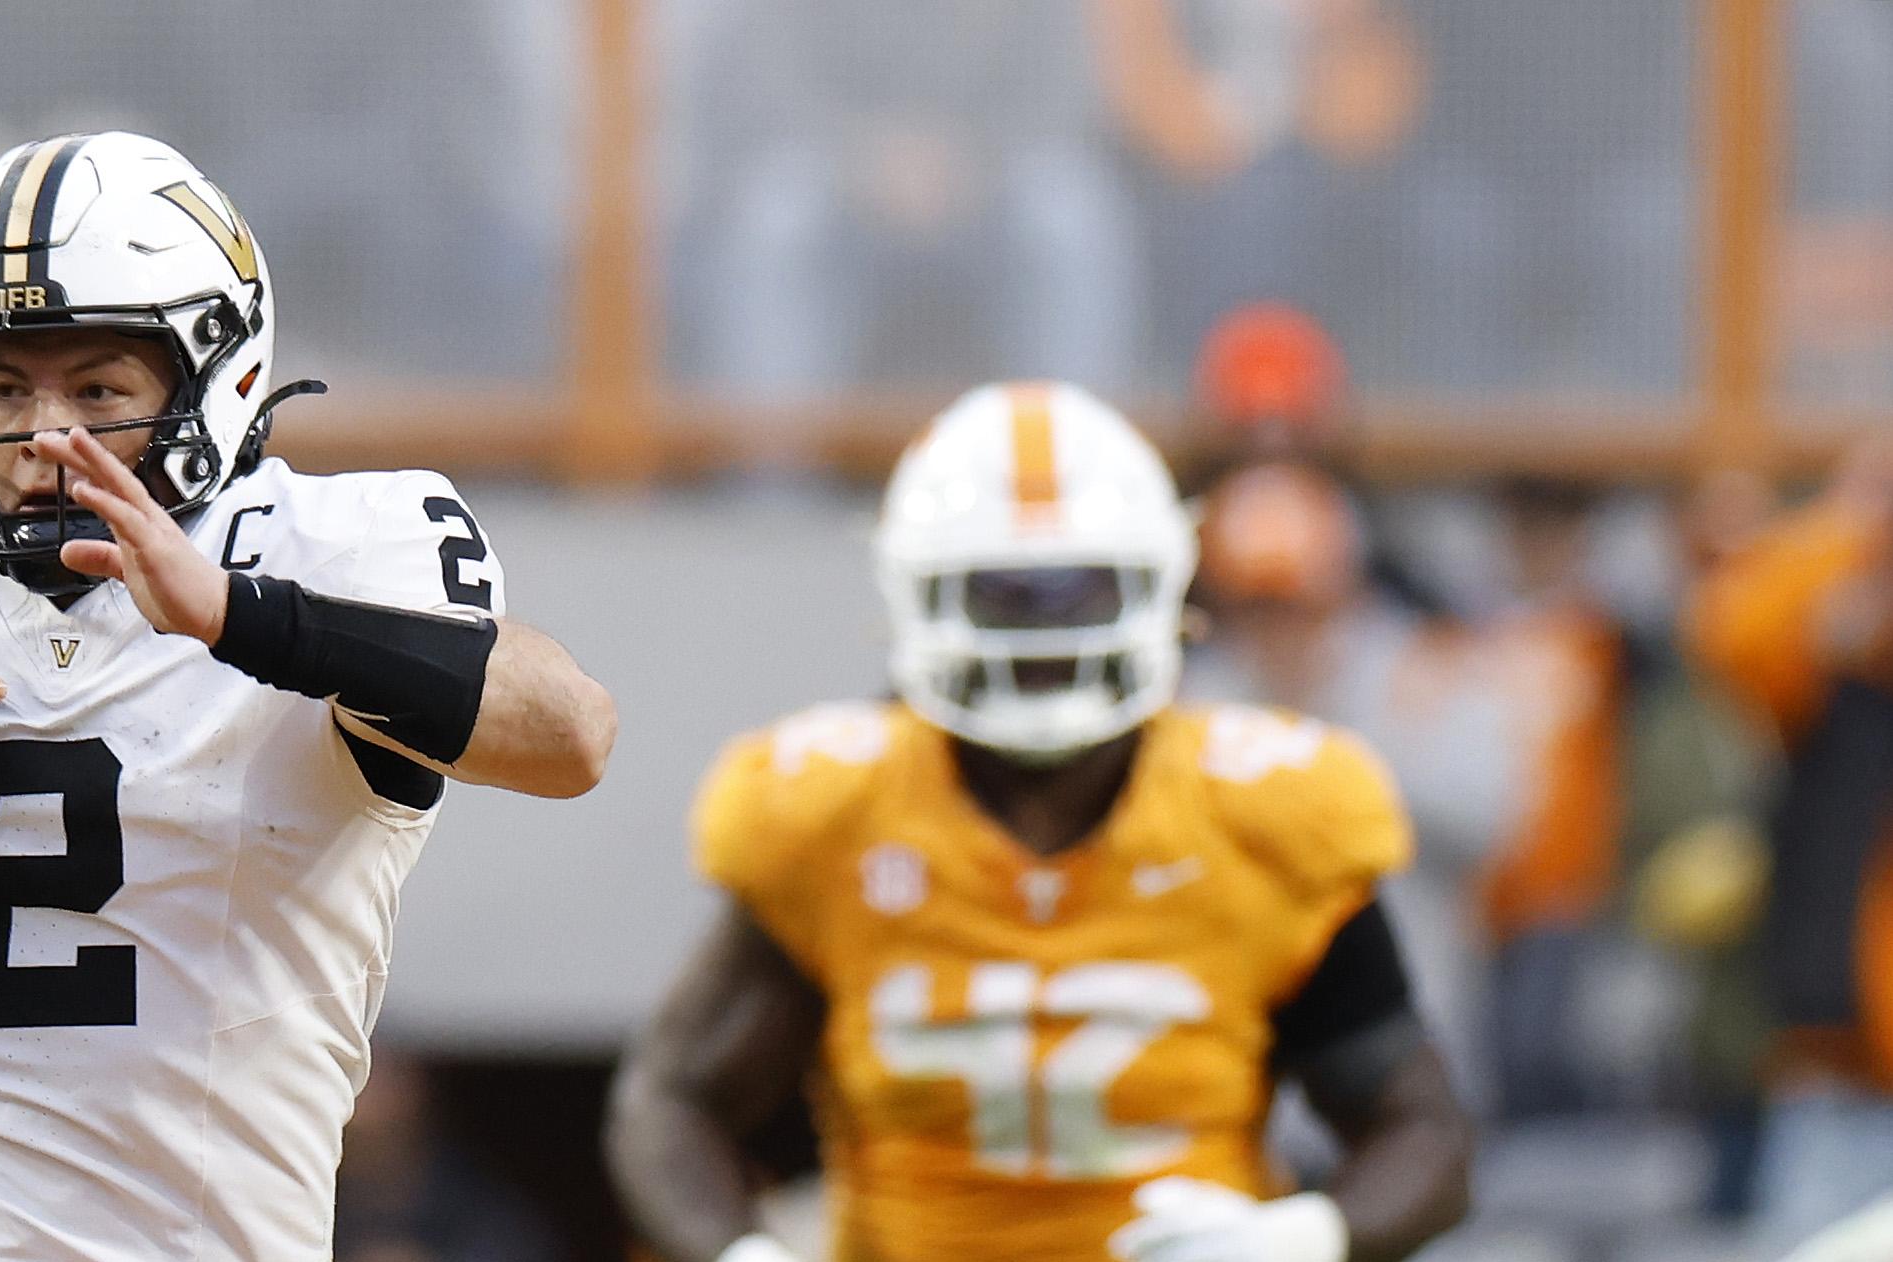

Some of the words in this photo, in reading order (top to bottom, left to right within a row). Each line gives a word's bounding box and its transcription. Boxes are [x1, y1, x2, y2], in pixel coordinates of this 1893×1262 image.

[221, 504, 274, 571] C
[423, 496, 492, 612] 2
[49, 638, 81, 668] V
[869, 962, 1214, 1183] 42
